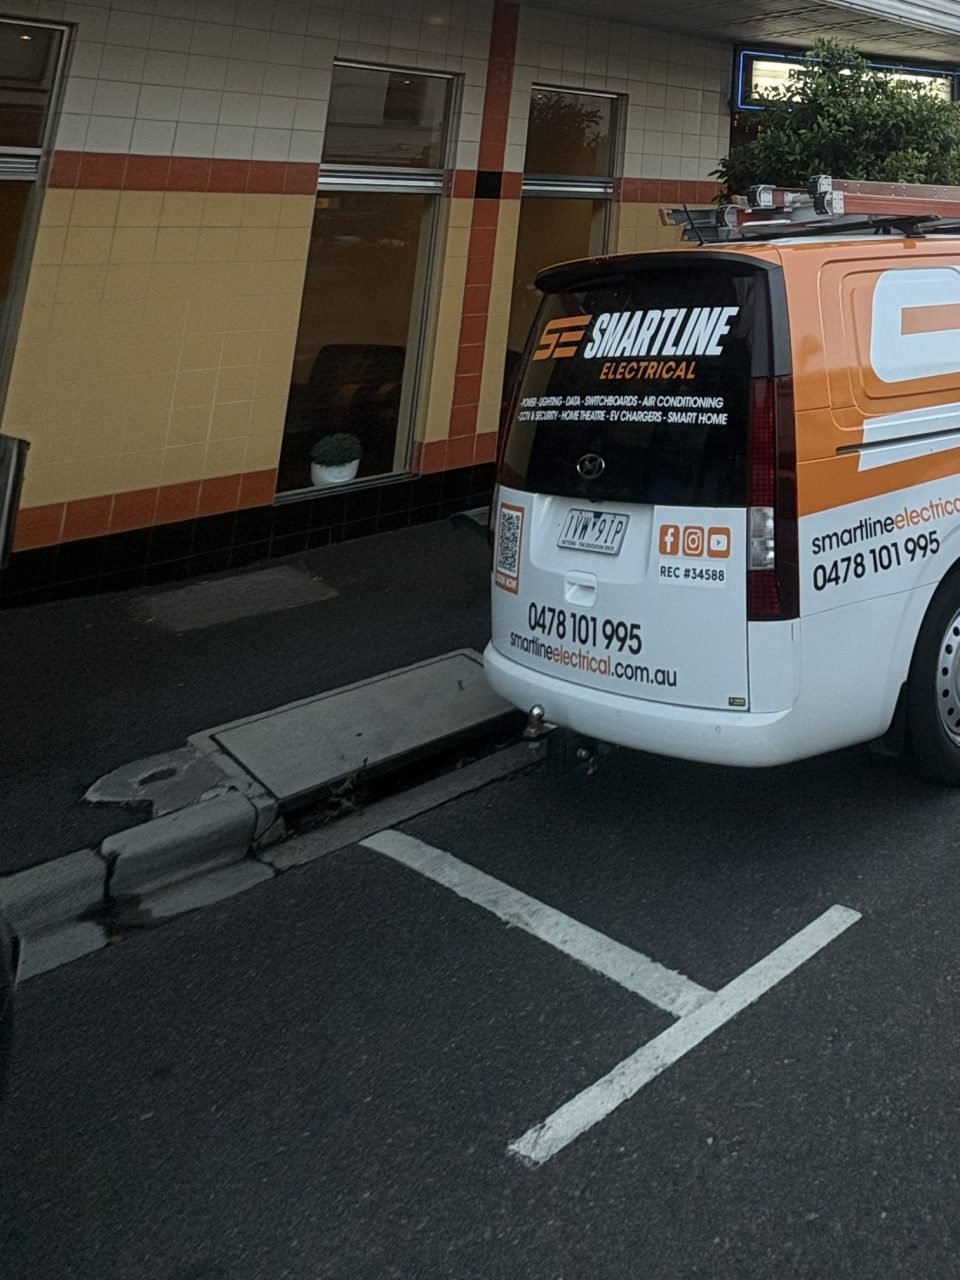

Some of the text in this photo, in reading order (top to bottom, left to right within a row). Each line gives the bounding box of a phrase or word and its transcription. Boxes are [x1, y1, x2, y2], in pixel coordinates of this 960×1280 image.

[583, 306, 740, 359] SMARTLINE
[599, 360, 696, 380] ELECTRICAL
[561, 410, 579, 421] HOME
[579, 410, 606, 421] THEATRE
[609, 410, 620, 421] EV
[620, 410, 662, 422] CHARGERS
[667, 411, 697, 424] SMART
[698, 412, 728, 425] HOME
[565, 395, 581, 406] DATA
[584, 395, 638, 406] SWITCHBOARDS
[642, 395, 656, 406] AIR
[656, 395, 724, 408] CONDITIONING
[660, 565, 725, 581] REC #34588
[813, 530, 941, 591] 0478 101 995
[528, 602, 642, 655] 0478 101 995
[510, 631, 677, 687] smartlineelectrical.com.au
